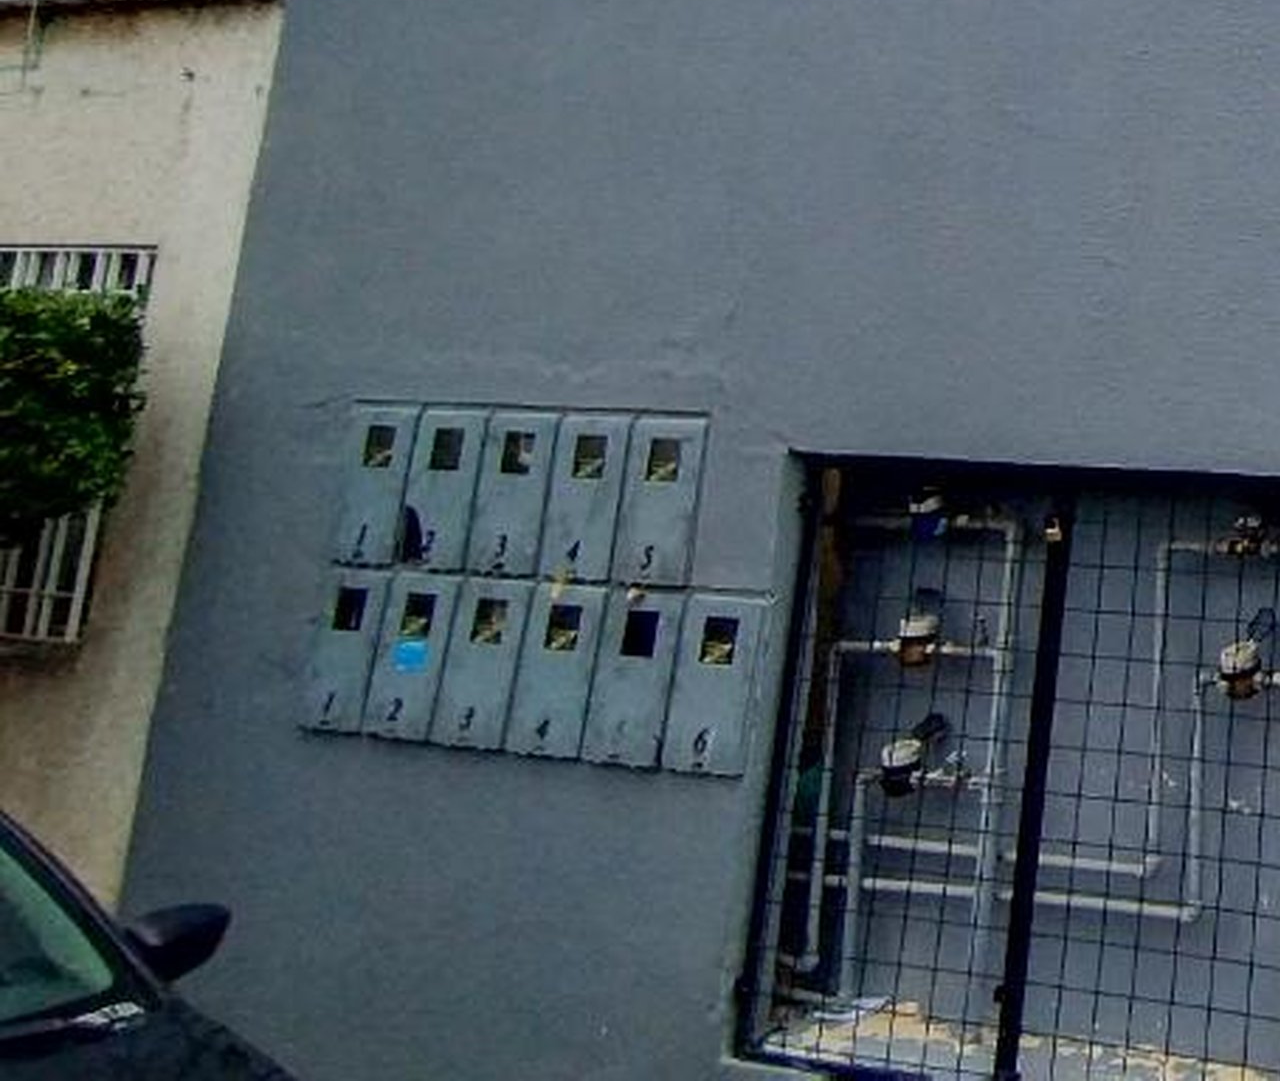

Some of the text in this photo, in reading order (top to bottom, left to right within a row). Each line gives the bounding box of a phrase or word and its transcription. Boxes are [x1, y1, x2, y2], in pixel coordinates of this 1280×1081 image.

[566, 540, 581, 562] 4
[386, 699, 403, 722] 2
[459, 706, 474, 731] 3
[694, 728, 710, 754] 6
